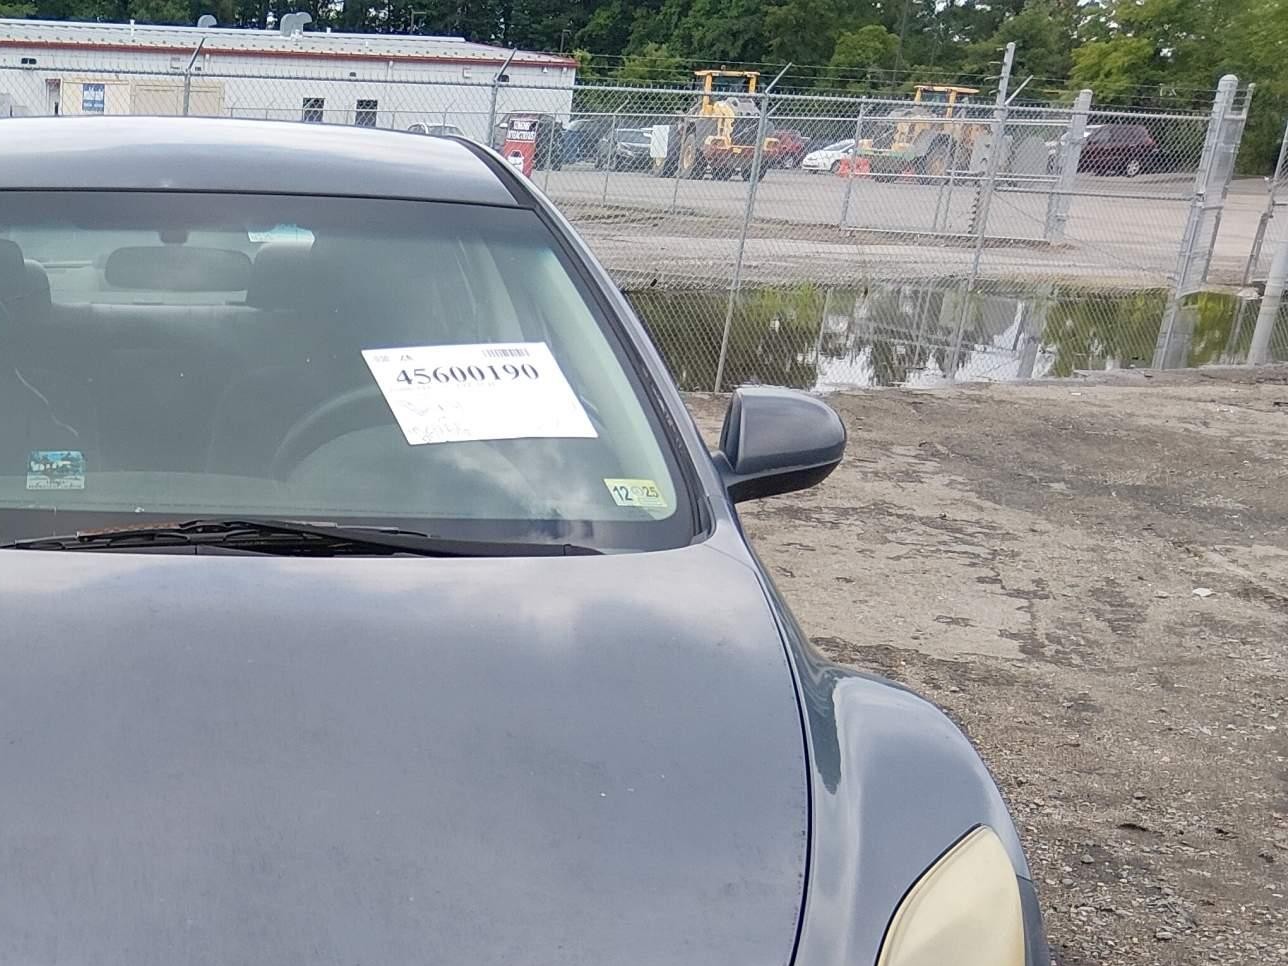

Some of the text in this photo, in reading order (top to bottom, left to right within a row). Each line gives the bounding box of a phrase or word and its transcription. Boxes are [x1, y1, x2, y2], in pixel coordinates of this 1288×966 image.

[396, 363, 540, 385] 45600190
[612, 486, 659, 502] 12 25
